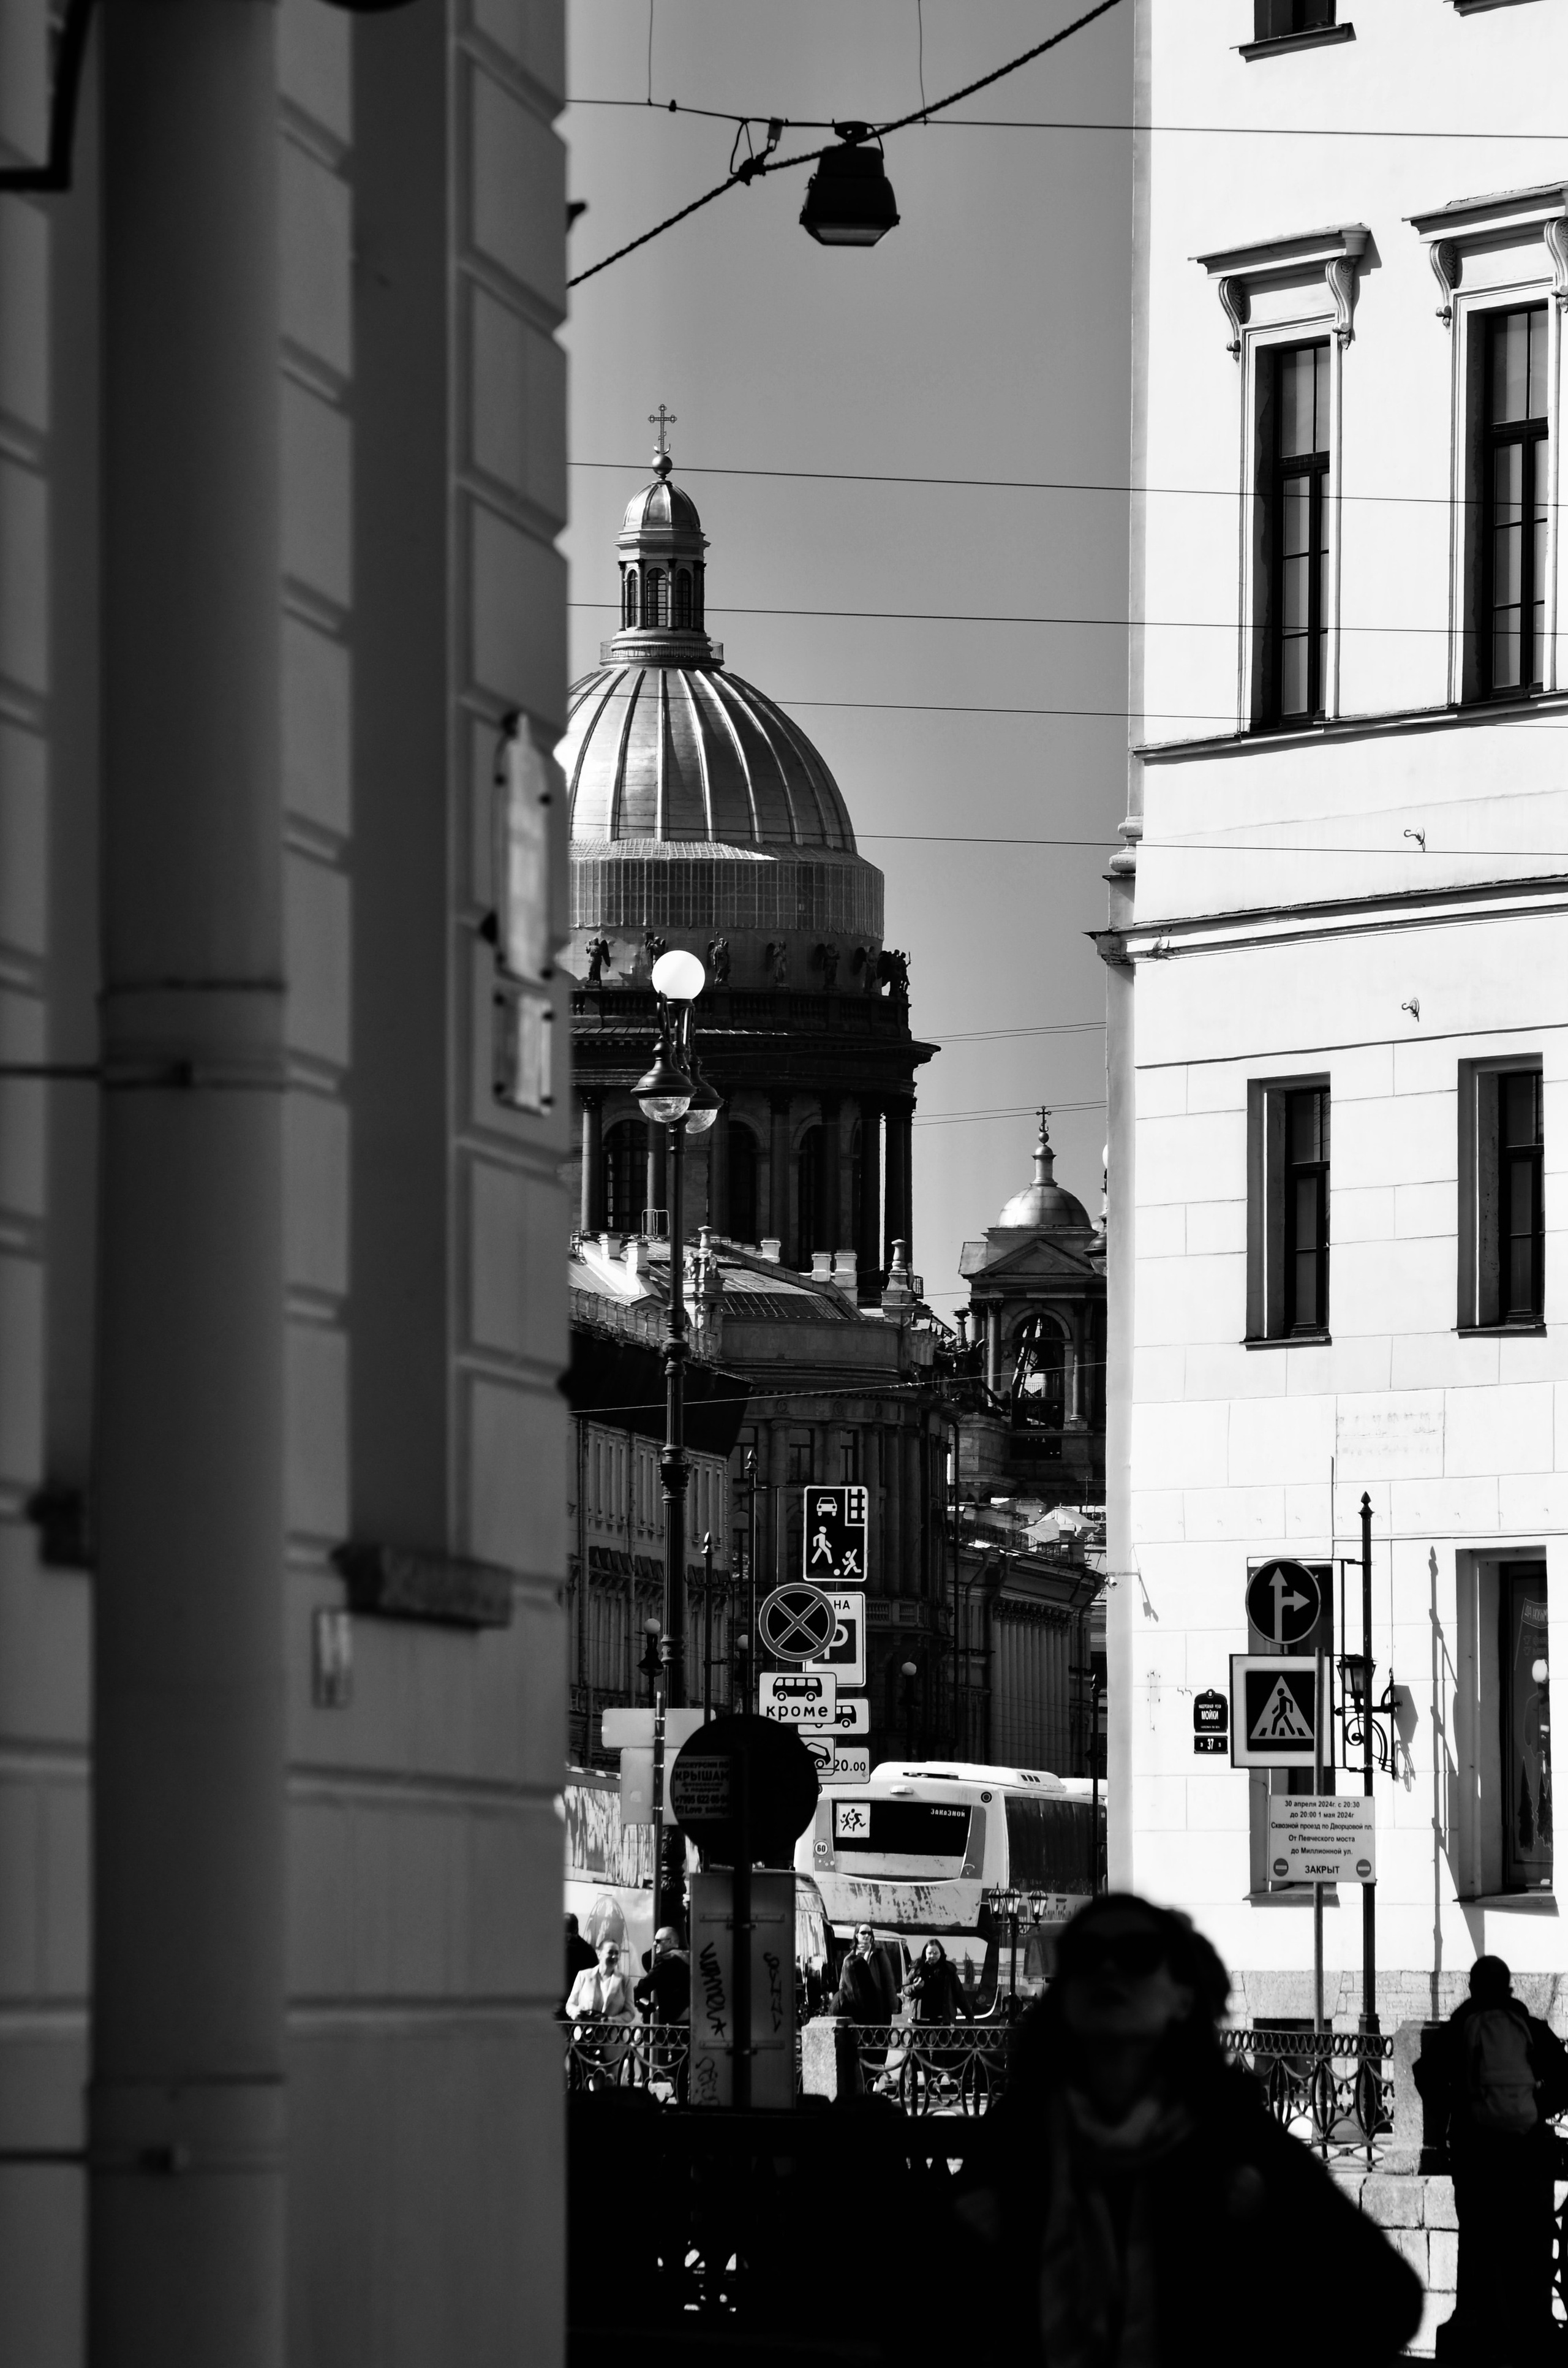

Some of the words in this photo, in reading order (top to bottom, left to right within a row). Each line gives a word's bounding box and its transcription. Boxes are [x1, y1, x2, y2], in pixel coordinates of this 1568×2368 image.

[834, 1600, 851, 1610] НА
[766, 1705, 828, 1721] кроме
[1201, 1709, 1219, 1720] МОЙКИ
[1207, 1738, 1214, 1750] 37
[676, 1771, 729, 1781] КРЫШАМ
[930, 1808, 965, 1817] ЗАКАЗНОЙ
[1305, 1865, 1340, 1874] ЗАКРЫТ
